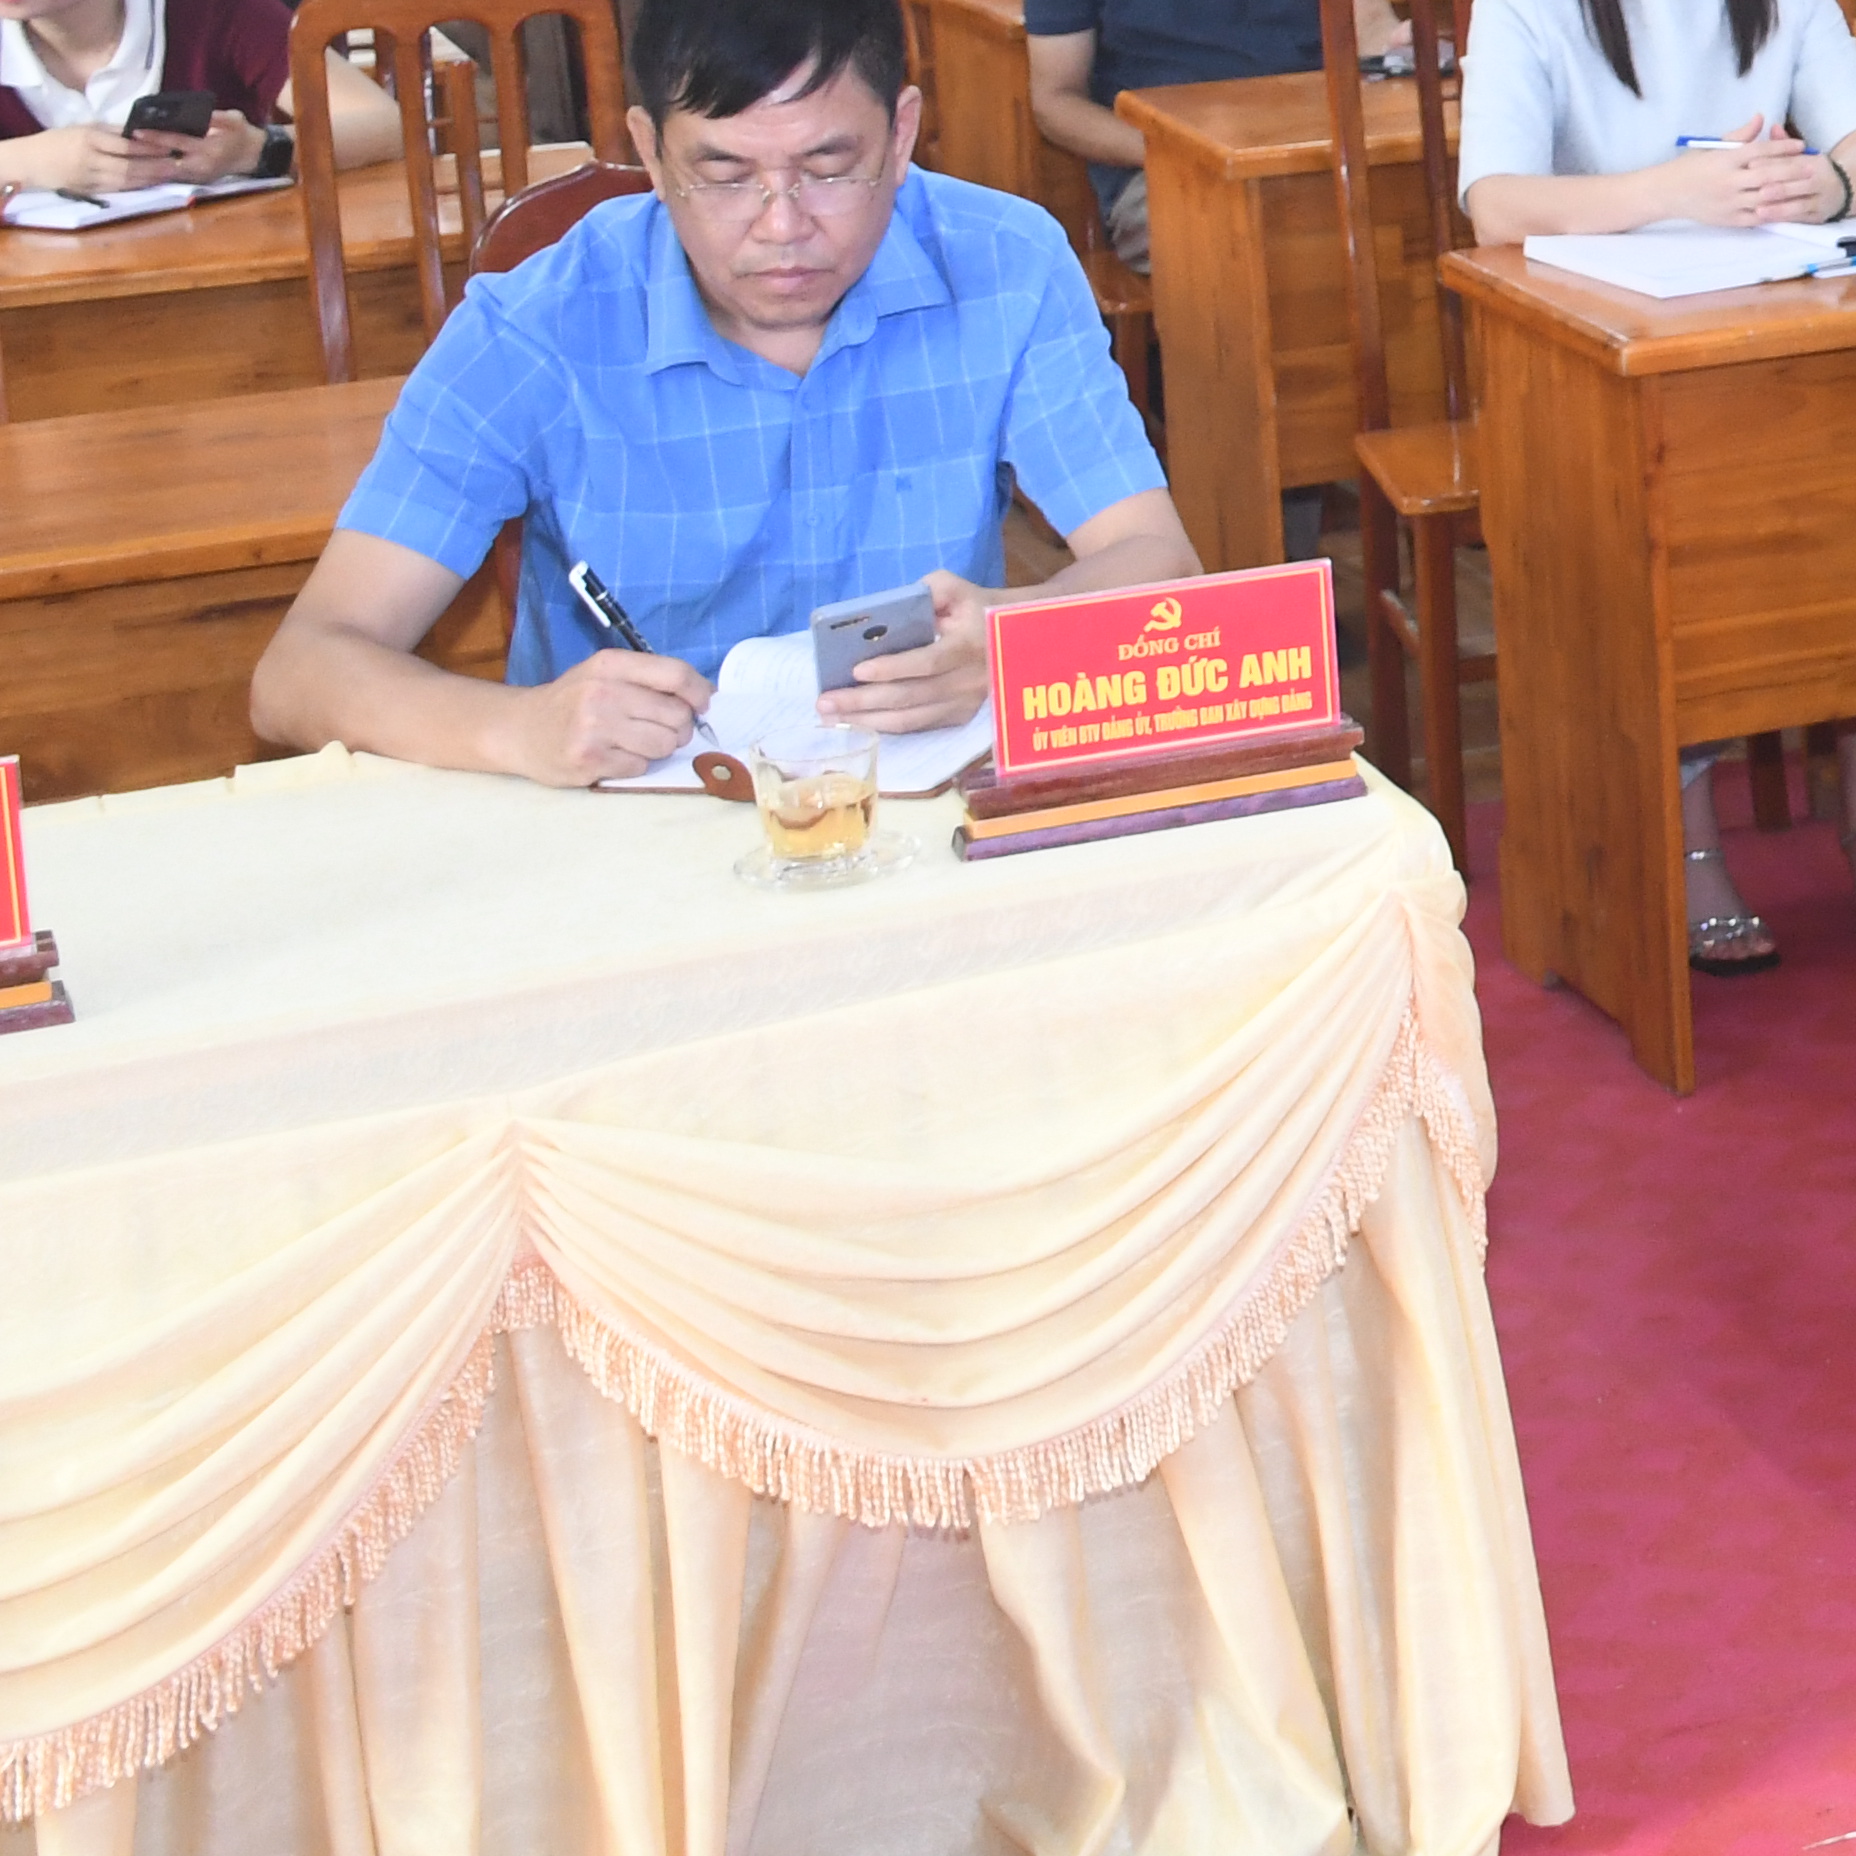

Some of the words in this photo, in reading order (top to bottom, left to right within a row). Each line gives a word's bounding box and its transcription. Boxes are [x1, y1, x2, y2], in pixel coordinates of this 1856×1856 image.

[1117, 633, 1180, 662] ĐỒNG
[1183, 625, 1222, 651] CHÍ
[1022, 671, 1147, 721] HOÀNG
[1156, 655, 1229, 700] ĐỨC
[1238, 645, 1313, 689] ANH
[1200, 705, 1224, 726] BAN
